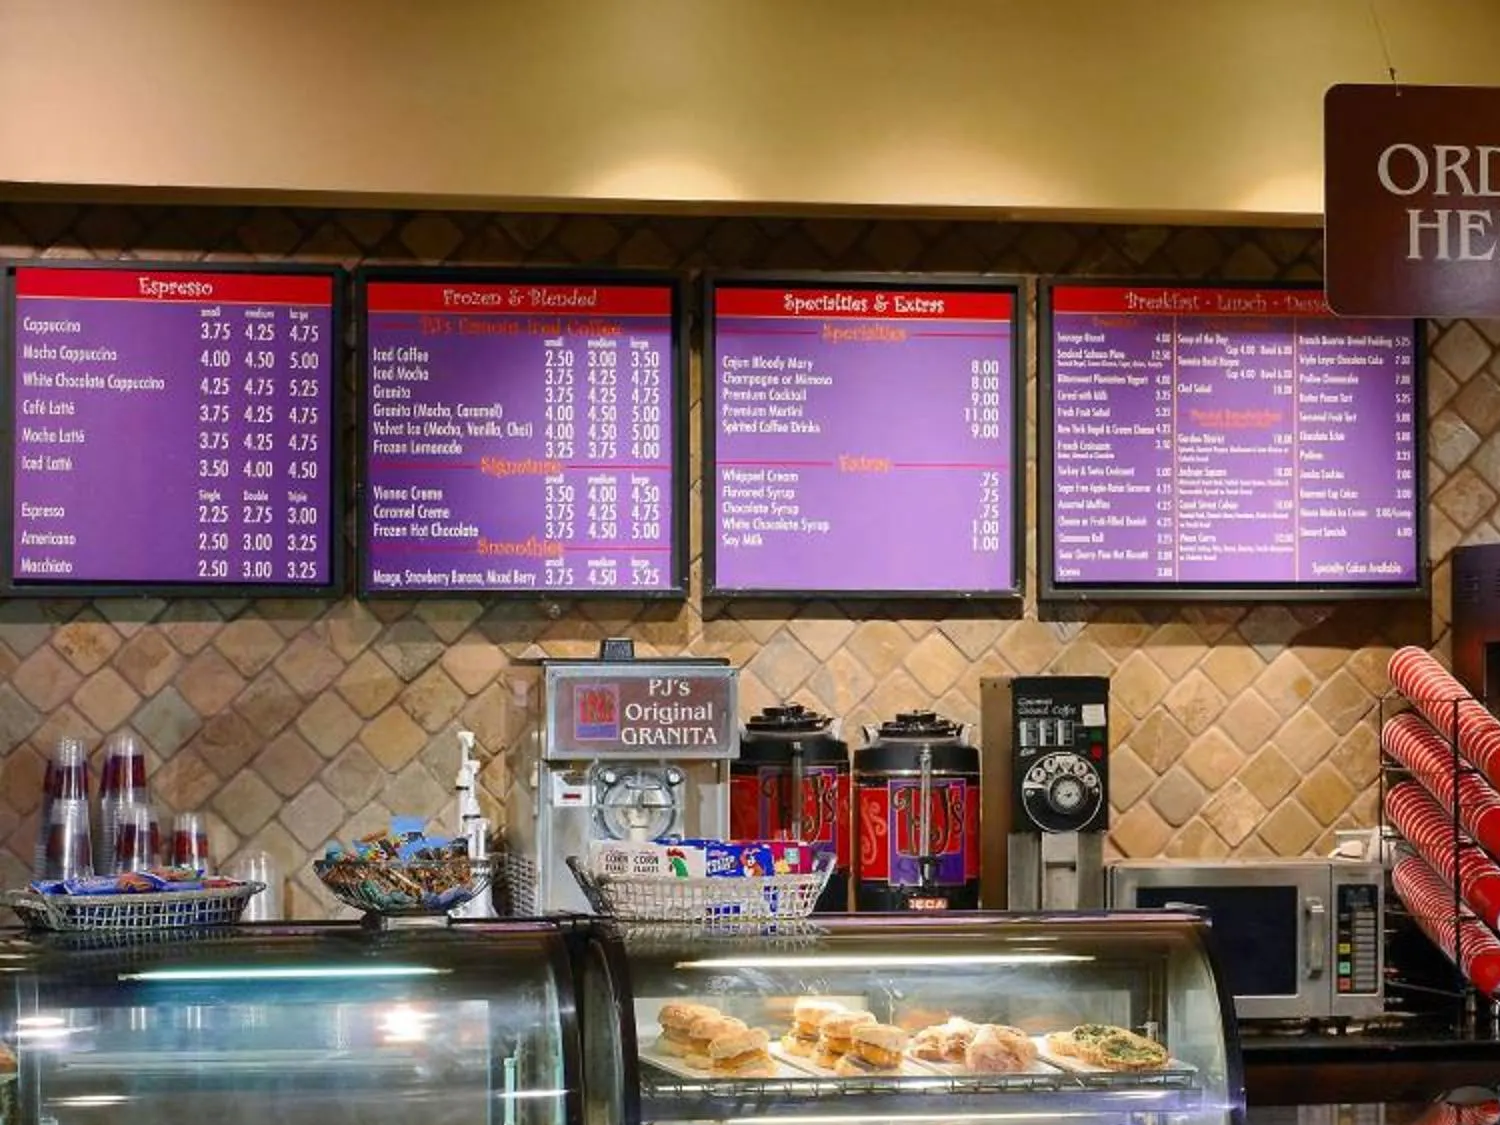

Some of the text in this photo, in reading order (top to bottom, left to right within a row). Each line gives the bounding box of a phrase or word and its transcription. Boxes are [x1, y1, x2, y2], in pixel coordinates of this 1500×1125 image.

[139, 277, 212, 300] Espresso
[444, 288, 596, 306] Frozen & Blended
[784, 294, 944, 314] Specialties & Extras
[201, 322, 230, 339] 3.75
[245, 324, 274, 340] 4.25
[290, 325, 318, 342] 4.75
[201, 350, 230, 367] 4.00
[245, 352, 274, 368] 4.50
[290, 352, 318, 369] 5.00
[546, 350, 574, 367] 2.50
[588, 351, 616, 367] 3.00
[631, 352, 659, 368] 3.50
[972, 360, 998, 375] 8.00
[201, 378, 229, 394] 4.25
[244, 378, 273, 395] 4.75
[290, 379, 318, 396] 5.25
[546, 368, 573, 385] 3.75
[588, 369, 616, 385] 4.25
[632, 369, 659, 388] 4.75
[972, 376, 998, 391] 8.00
[546, 385, 659, 404] 3.75 4.25 4.75
[972, 392, 998, 406] 9.00
[200, 405, 229, 422] 3.75
[244, 406, 273, 422] 4.25
[289, 407, 317, 424] 4.75
[546, 405, 660, 422] 4.00 4.50 5.00
[966, 408, 998, 422] 11.00
[546, 423, 574, 440] 4.00
[588, 423, 617, 440] 4.50
[632, 424, 659, 440] 5.00
[972, 423, 998, 438] 9.00
[200, 432, 228, 449] 3.75
[244, 434, 272, 450] 4.25
[288, 434, 317, 451] 4.75
[546, 441, 574, 458] 3.25
[589, 442, 616, 458] 3.75
[632, 442, 659, 458] 4.00
[200, 460, 228, 477] 3.50
[244, 460, 272, 477] 4.00
[288, 462, 317, 478] 4.50
[980, 472, 998, 486] .75
[546, 486, 574, 502] 3.50
[589, 486, 616, 502] 4.00
[632, 483, 659, 502] 4.50
[980, 488, 998, 502] .75
[22, 502, 316, 524] Espresso 2.25 2.75 3.00
[546, 504, 574, 520] 3.75
[588, 504, 616, 521] 4.25
[632, 504, 659, 520] 4.75
[980, 504, 999, 519] .75
[546, 522, 574, 538] 3.75
[588, 522, 617, 538] 4.50
[632, 522, 659, 539] 5.00
[974, 520, 998, 534] 1.00
[200, 532, 228, 550] 2.50
[244, 534, 272, 550] 3.00
[288, 534, 316, 551] 3.25
[973, 535, 998, 550] 1.00
[199, 560, 228, 576] 2.50
[243, 561, 272, 578] 3.00
[288, 562, 316, 578] 3.25
[546, 566, 659, 585] 3.75 4.50 5.25
[649, 678, 691, 696] PJ's
[625, 702, 713, 724] Original
[622, 728, 718, 745] GRANITA
